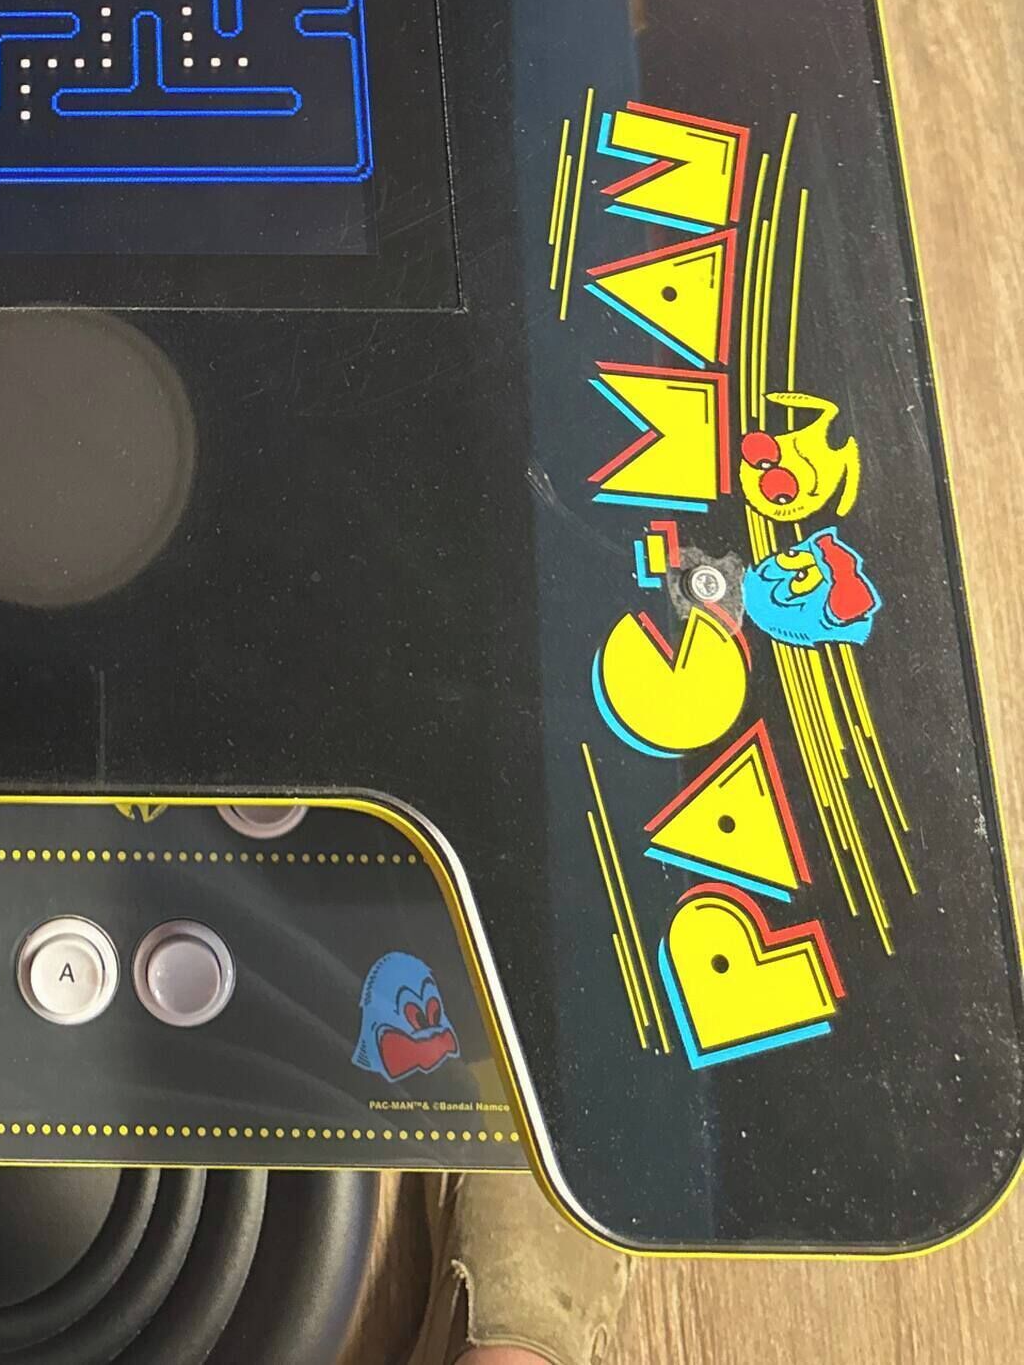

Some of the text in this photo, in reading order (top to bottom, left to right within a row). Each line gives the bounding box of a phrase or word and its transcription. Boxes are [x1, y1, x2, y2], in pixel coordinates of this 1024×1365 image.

[586, 101, 845, 1070] PAC-MAN
[59, 962, 75, 982] A
[477, 1102, 510, 1112] Namco
